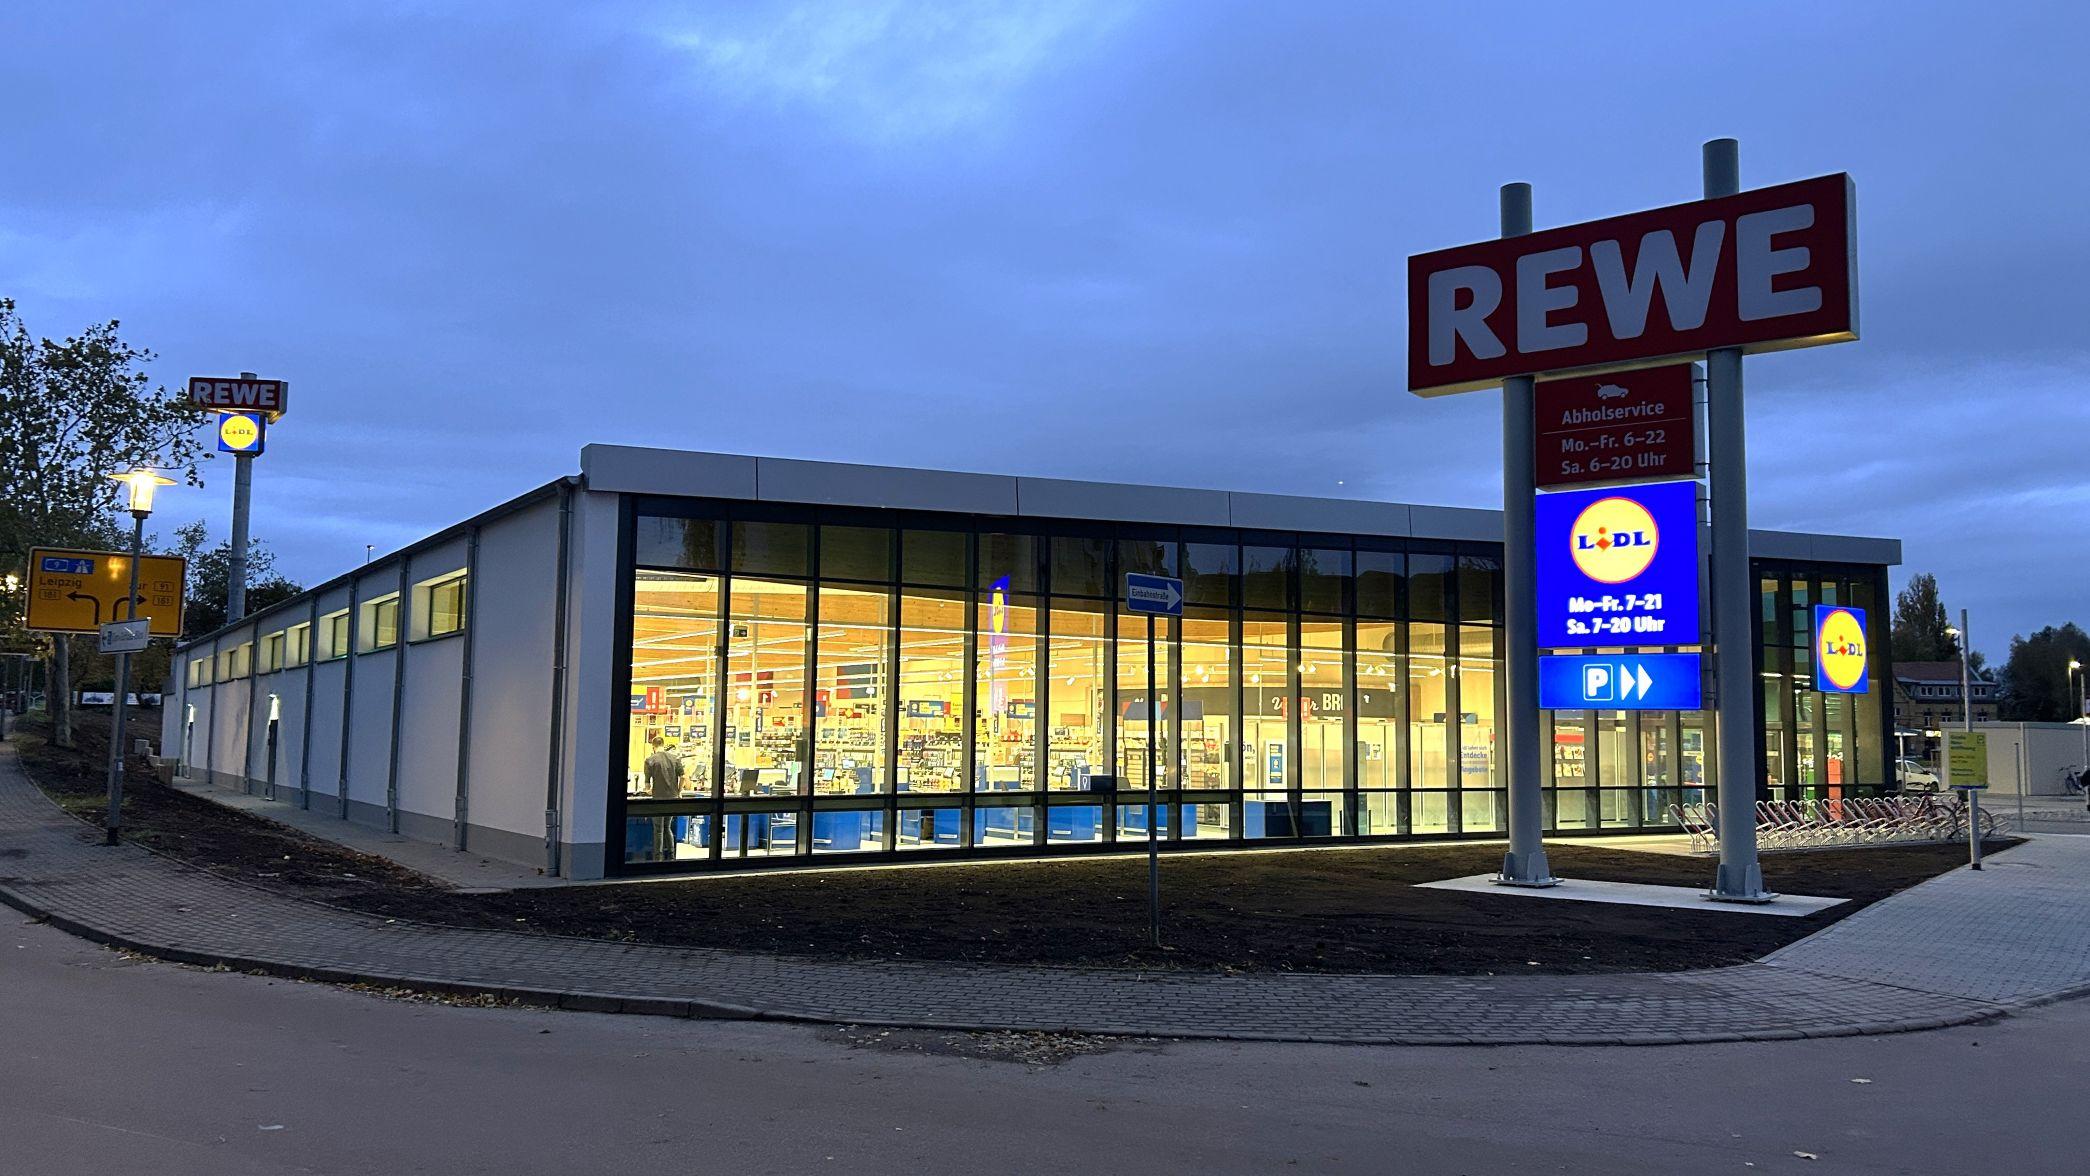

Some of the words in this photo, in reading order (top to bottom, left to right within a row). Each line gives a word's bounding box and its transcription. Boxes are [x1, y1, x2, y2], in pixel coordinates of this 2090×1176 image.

[1428, 204, 1822, 367] REWE
[193, 382, 275, 405] REWE
[1562, 401, 1665, 424] Abholservice
[1561, 461, 1585, 475] Sa.
[1638, 452, 1667, 467] Uhr
[39, 576, 82, 590] Leipzig
[1567, 618, 1591, 635] Sa.
[1633, 615, 1666, 633] Uhr
[1587, 668, 1609, 697] P
